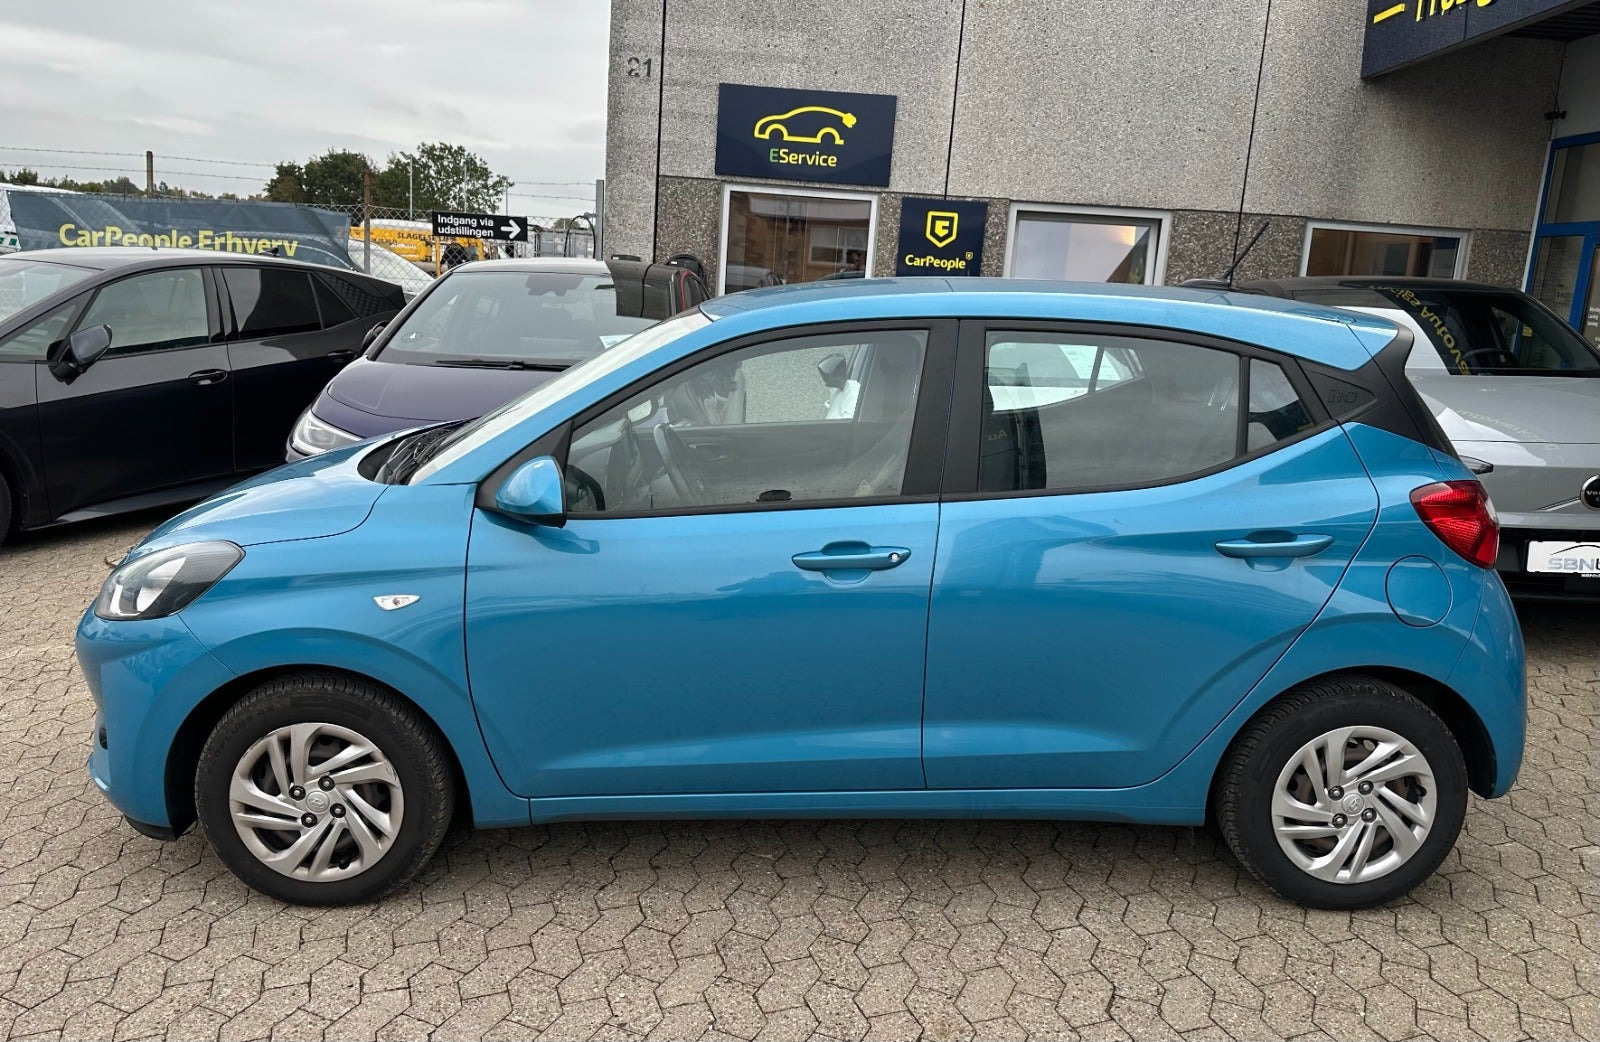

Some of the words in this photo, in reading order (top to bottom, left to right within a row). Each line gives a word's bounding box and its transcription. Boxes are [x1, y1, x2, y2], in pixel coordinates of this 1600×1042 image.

[627, 57, 652, 78] 21
[769, 148, 838, 168] EService
[437, 214, 478, 228] Indgang
[479, 217, 494, 227] via
[437, 225, 495, 238] udstillingen
[904, 253, 967, 272] CarPeople
